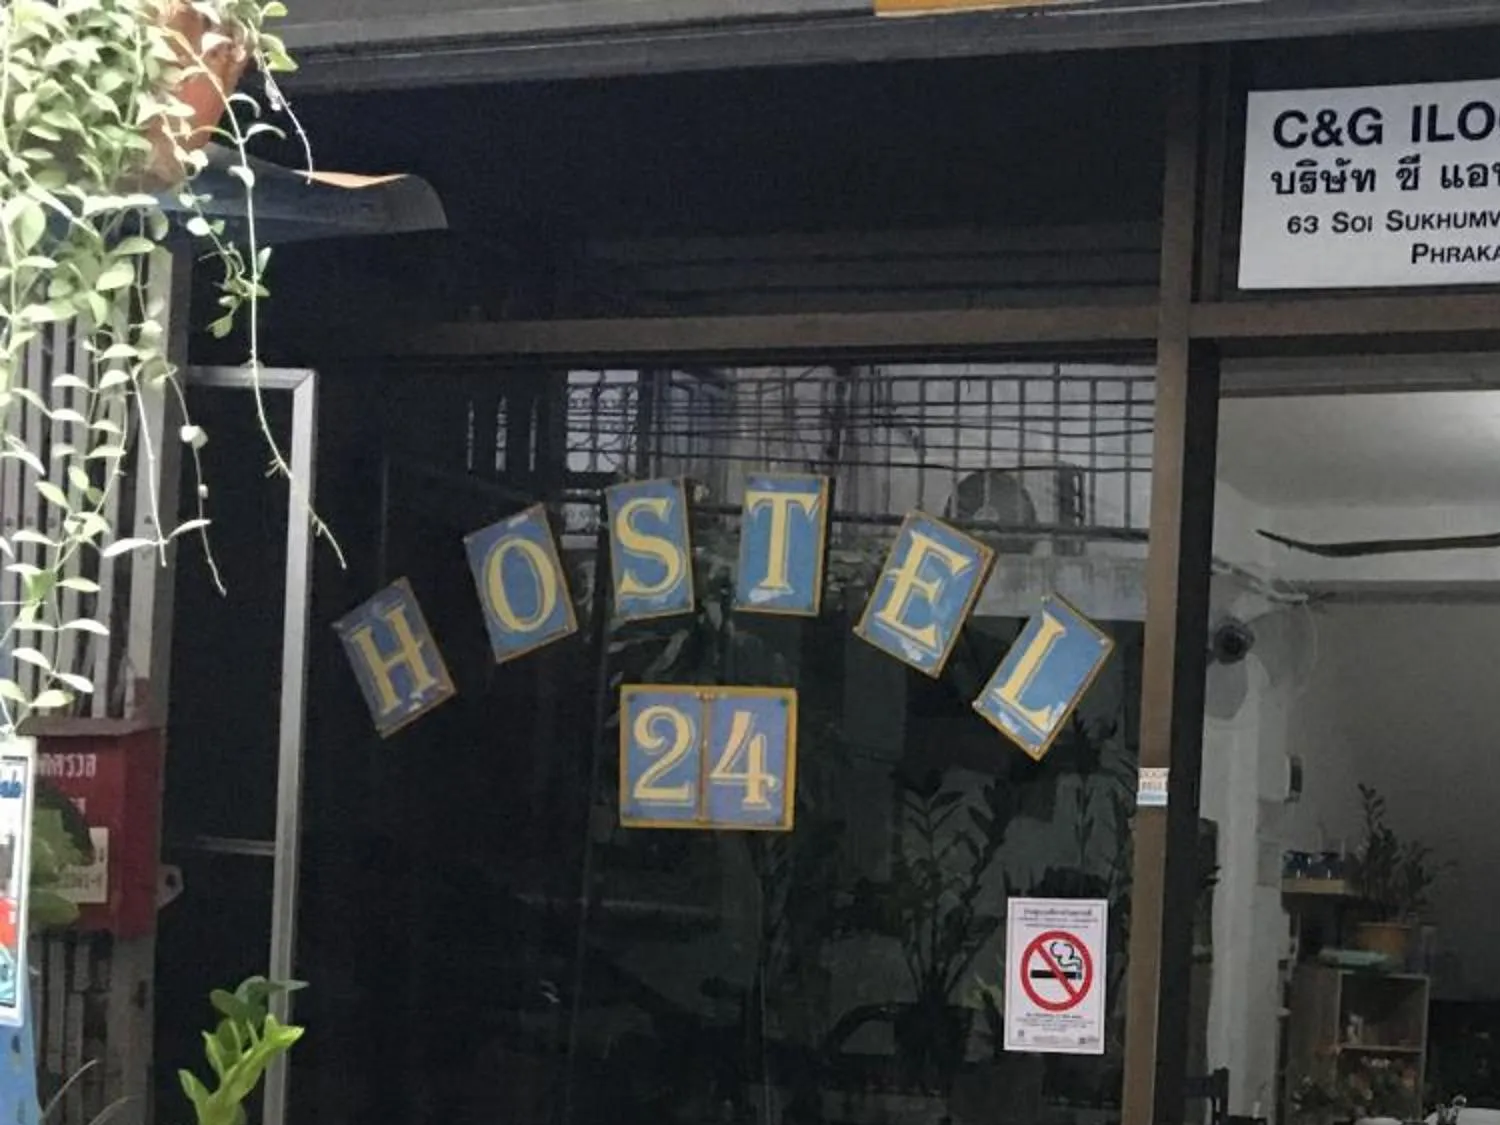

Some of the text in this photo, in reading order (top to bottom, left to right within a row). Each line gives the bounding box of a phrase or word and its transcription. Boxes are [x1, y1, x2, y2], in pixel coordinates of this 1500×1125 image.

[1273, 106, 1383, 149] C&G
[1271, 157, 1376, 195] บริษัท
[1287, 216, 1318, 234] 63
[350, 489, 1068, 734] HOSTEL
[632, 710, 781, 813] 24
